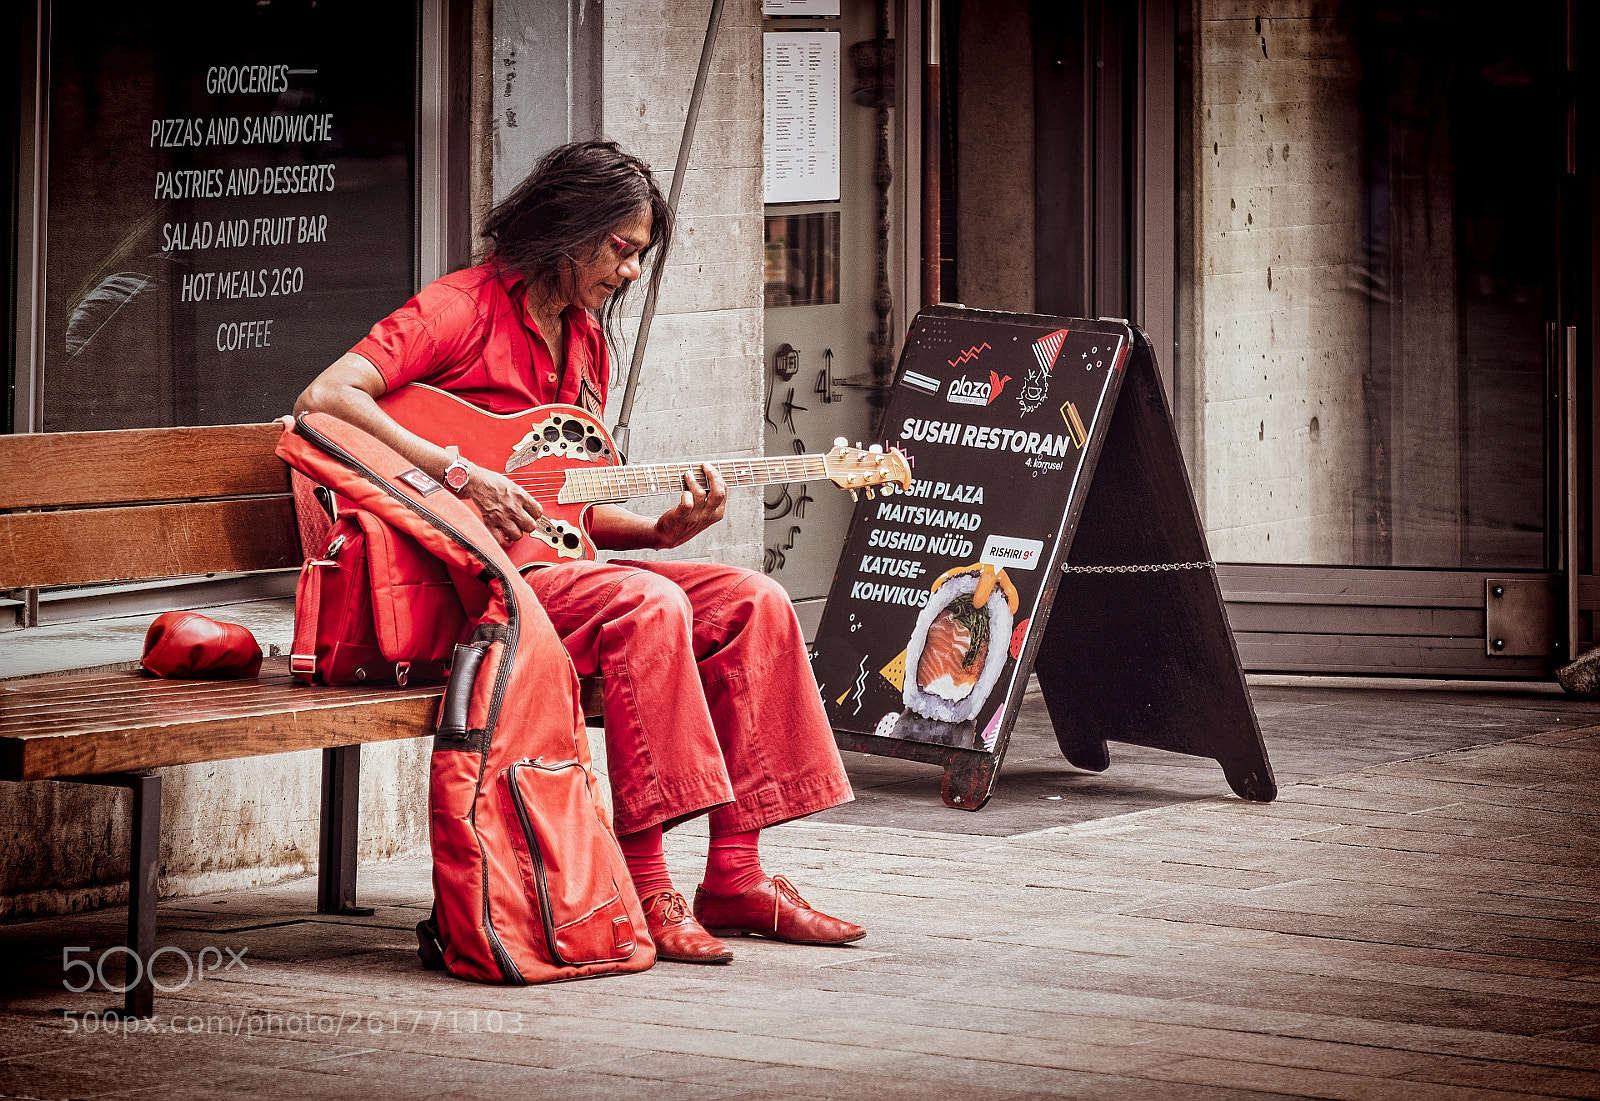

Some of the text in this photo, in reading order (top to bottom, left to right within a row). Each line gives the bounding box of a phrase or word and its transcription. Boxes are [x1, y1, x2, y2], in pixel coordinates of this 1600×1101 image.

[206, 65, 289, 94] GROCERIES
[150, 114, 333, 148] PIZZAS AND SANDWICHE
[154, 164, 336, 199] PASTRIES AND DESSERTS
[162, 215, 328, 251] SALAD AND FRUIT BAR
[181, 267, 304, 302] HOT MEALS 2GO
[216, 320, 273, 351] COFFEE
[946, 374, 992, 402] plaza
[900, 418, 1070, 458] SUSHI RESTORAN
[1033, 458, 1064, 471] korrusel
[885, 479, 984, 505] USHI PLAZA
[876, 502, 982, 531] MAITSVAMAD
[868, 529, 973, 558] SUSHID NÜÜD
[989, 546, 1022, 560] RISHIRI
[858, 554, 927, 579] KATUSE-
[850, 581, 930, 608] KOHVIKUS
